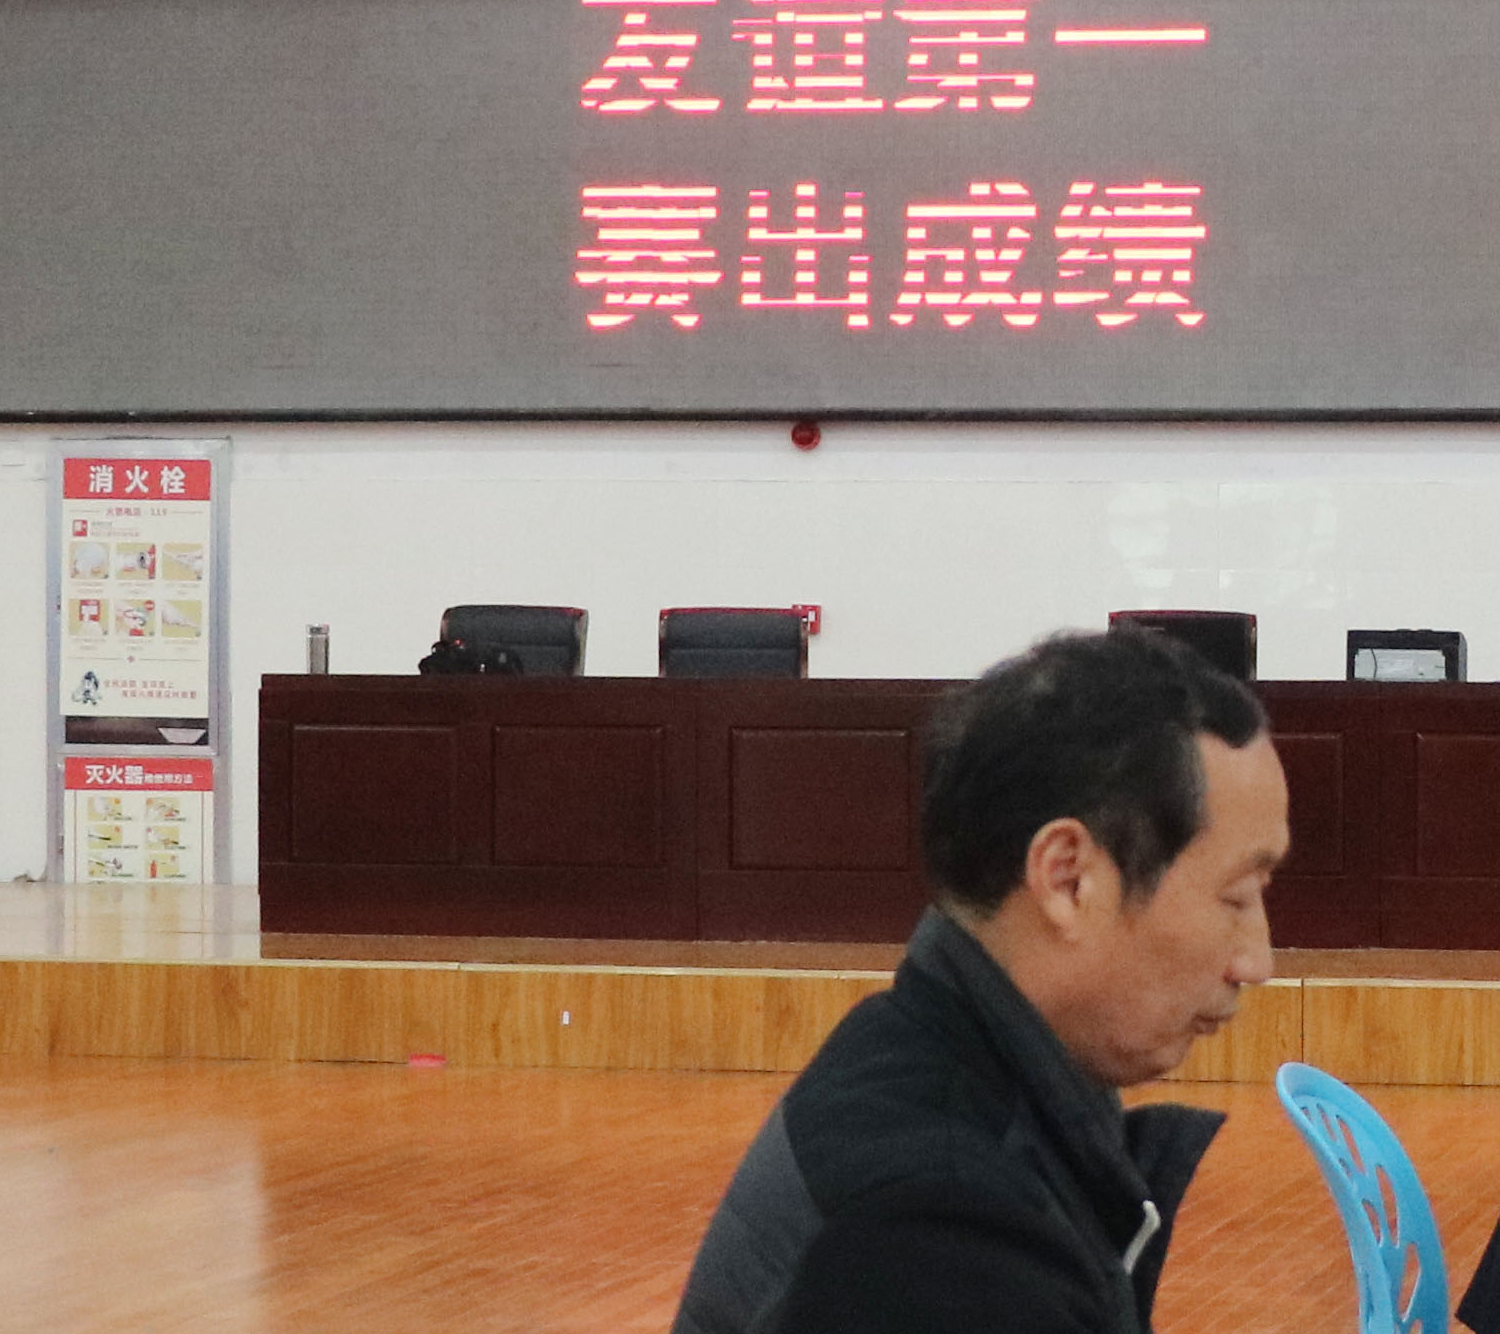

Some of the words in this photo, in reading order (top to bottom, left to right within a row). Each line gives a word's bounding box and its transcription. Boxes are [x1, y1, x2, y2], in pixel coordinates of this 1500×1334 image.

[574, 180, 1208, 330] 赛出成绩
[88, 464, 187, 495] 消火栓
